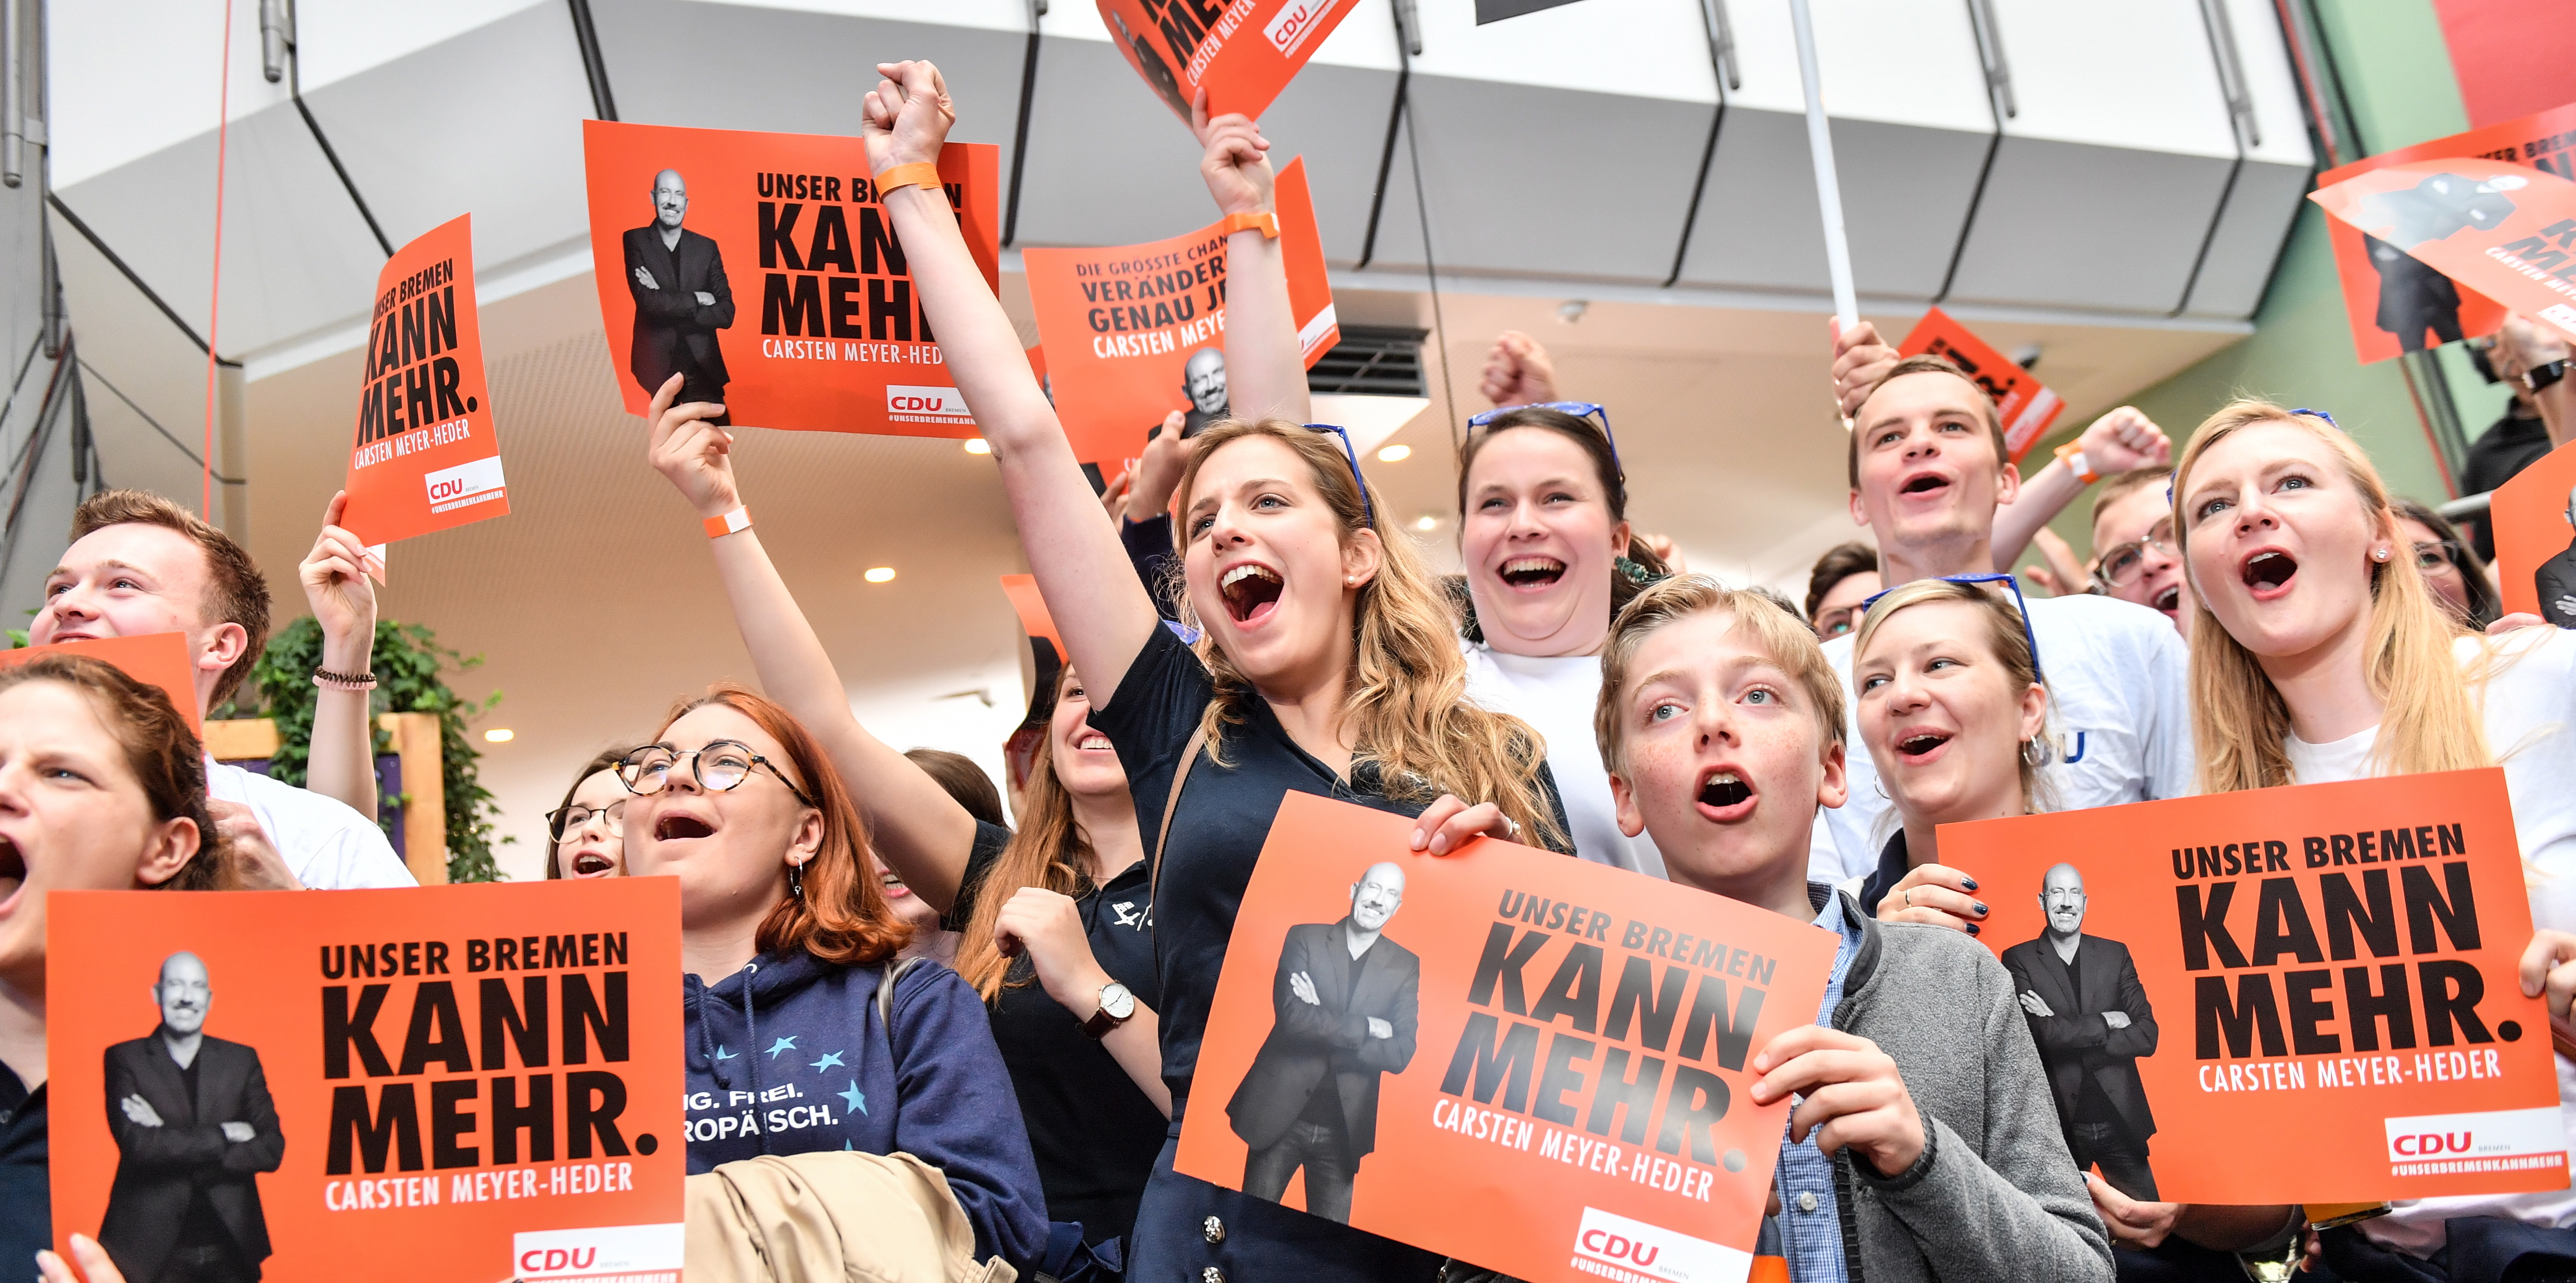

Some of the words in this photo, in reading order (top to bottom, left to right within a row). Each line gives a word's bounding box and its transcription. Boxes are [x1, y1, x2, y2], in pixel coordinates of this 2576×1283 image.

[1275, 5, 1307, 45] CDU
[1186, 33, 1223, 87] CARSTEN
[757, 172, 842, 201] UNSER
[758, 201, 962, 276] KAN
[1076, 263, 1103, 277] DIE
[1109, 252, 1180, 275] GRÖSSTE
[1187, 234, 1228, 261] CHAN
[399, 257, 454, 304] BREMEN
[1080, 250, 1228, 303] VERÄNDER
[761, 273, 936, 343] MEH
[1088, 294, 1195, 333] GENAU
[364, 284, 458, 388] KANN
[762, 338, 836, 361] CARSTEN
[844, 344, 944, 365] MEYER-HED
[1093, 332, 1175, 359] CARSTEN
[357, 356, 478, 448] MEHR.
[889, 414, 976, 426] #UNSERBREMENKANN
[891, 396, 943, 412] CDU
[354, 440, 393, 470] CARSTEN
[396, 418, 470, 457] MEYER-HEDER
[430, 478, 463, 500] CDU
[432, 490, 504, 514] #UNSERBREMENKANNMEHR
[2172, 840, 2291, 880] UNSER
[2303, 823, 2466, 869] BREMEN
[1498, 888, 1613, 943] UNSER
[1621, 919, 1777, 986] BREMEN
[2175, 861, 2482, 971] KANN
[320, 941, 450, 980] UNSER
[466, 932, 628, 973] BREMEN
[1467, 921, 1767, 1073] KANN
[2194, 959, 2523, 1060] MEHR.
[321, 970, 630, 1080] KANN
[1439, 1010, 1747, 1174] MEHR.
[2199, 1061, 2306, 1093] CARSTEN
[2318, 1048, 2501, 1089] MEYER-HEDER
[325, 1070, 658, 1176] MEHR.
[2393, 1130, 2472, 1156] CDU
[2478, 1144, 2511, 1153] BREMEN
[1432, 1098, 1534, 1152] CARSTEN
[1539, 1130, 1714, 1203] MEYER-HEDER
[2391, 1154, 2563, 1177] #UNSERBREMENKANNMEHR
[325, 1176, 440, 1212] CARSTEN
[452, 1162, 633, 1203] MEYER-HEDER
[520, 1247, 597, 1272] CDU
[1581, 1229, 1659, 1266] CDU
[1658, 1265, 1689, 1279] BREMEN
